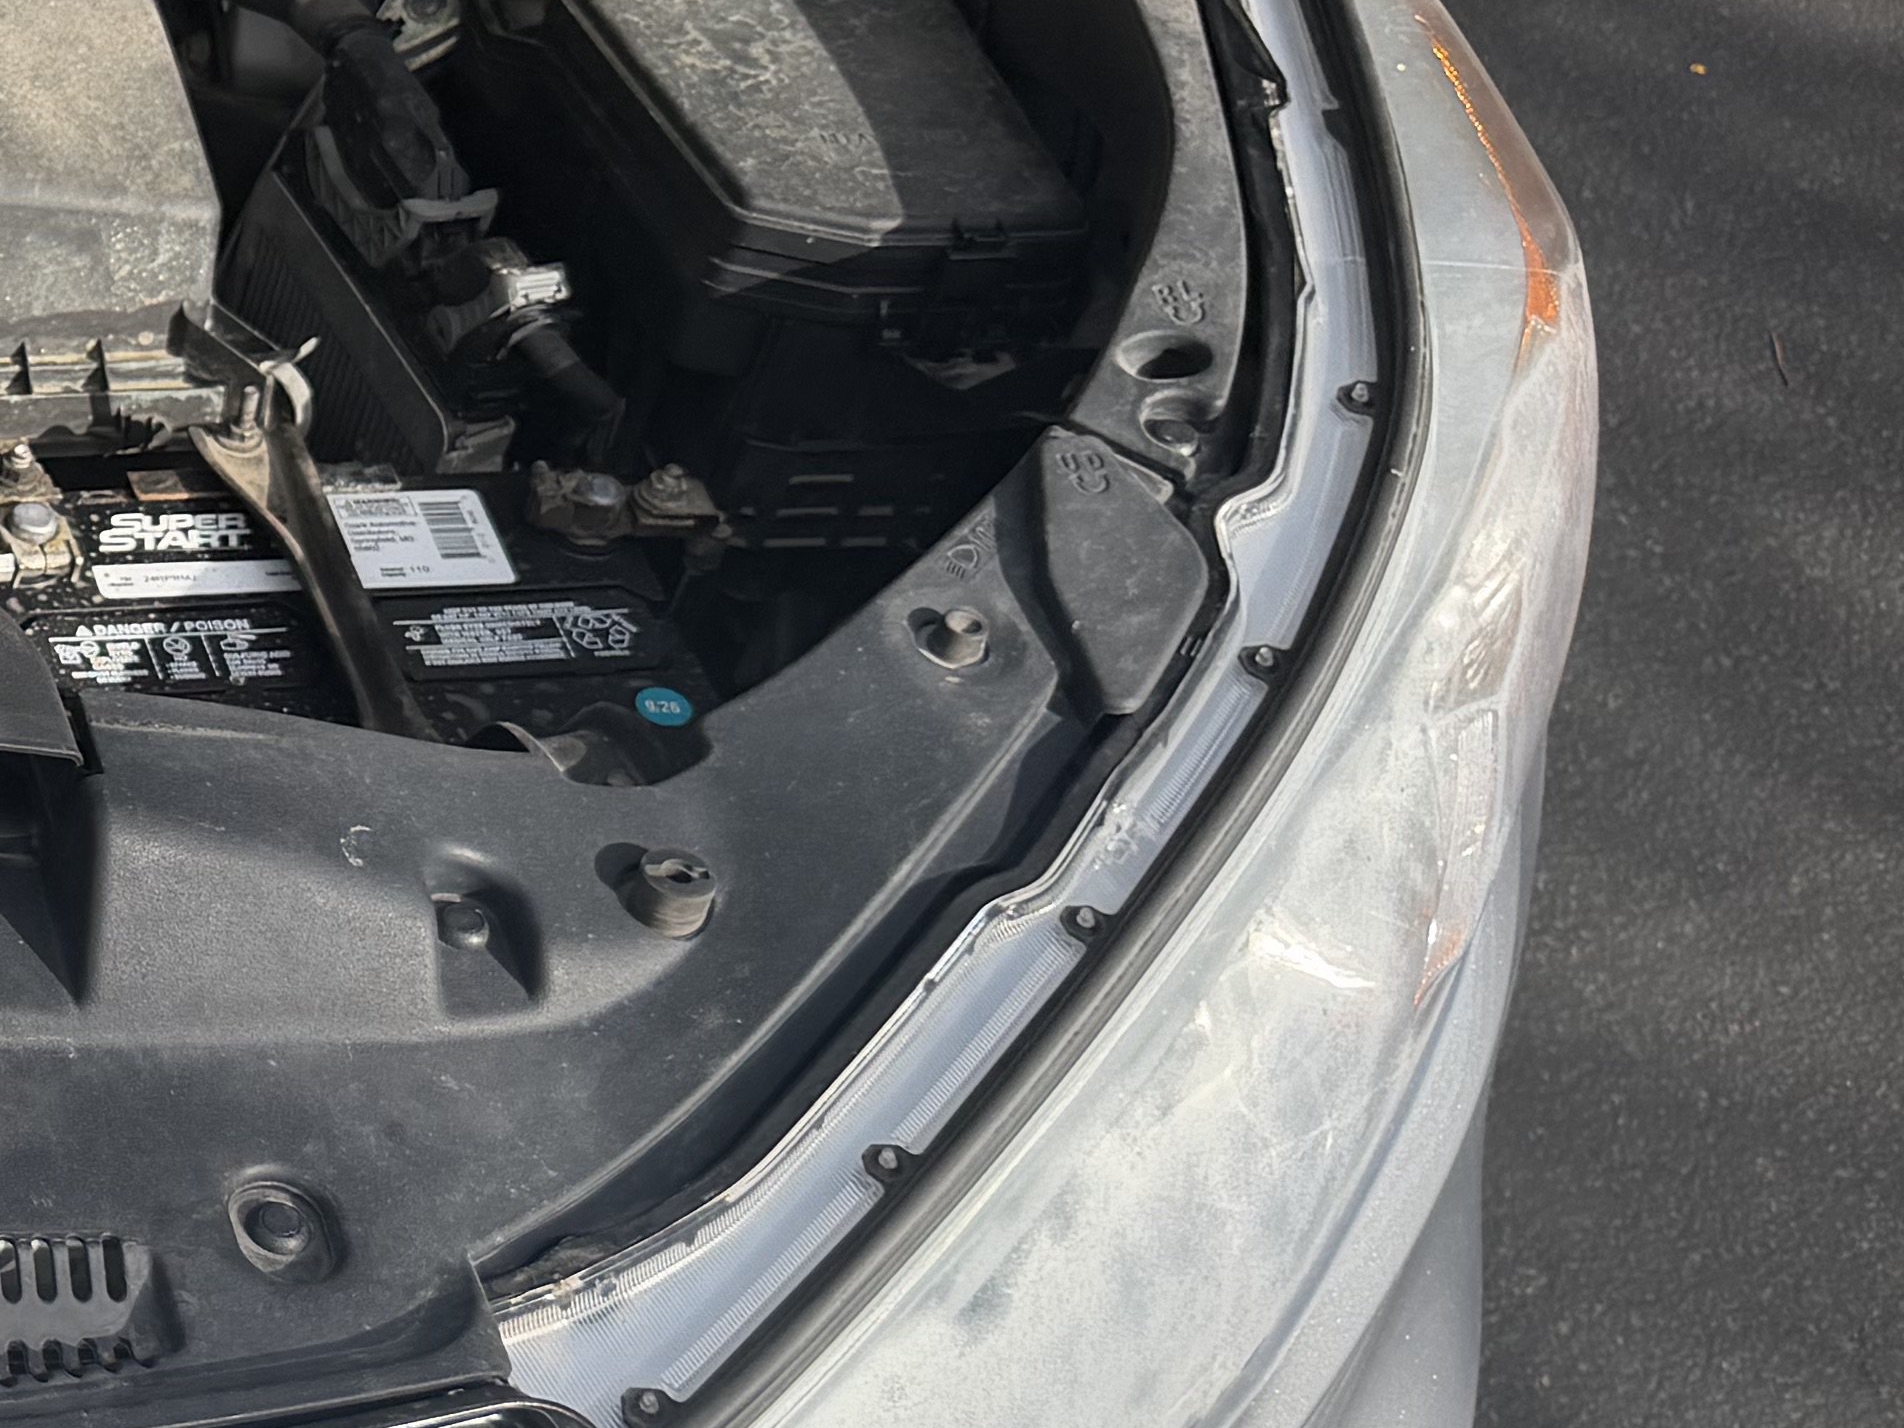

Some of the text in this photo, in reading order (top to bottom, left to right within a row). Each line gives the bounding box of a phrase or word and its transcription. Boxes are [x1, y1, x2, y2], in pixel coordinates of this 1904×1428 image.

[110, 512, 246, 533] SUPER
[98, 527, 253, 553] START
[93, 618, 251, 637] DANGER / POISON
